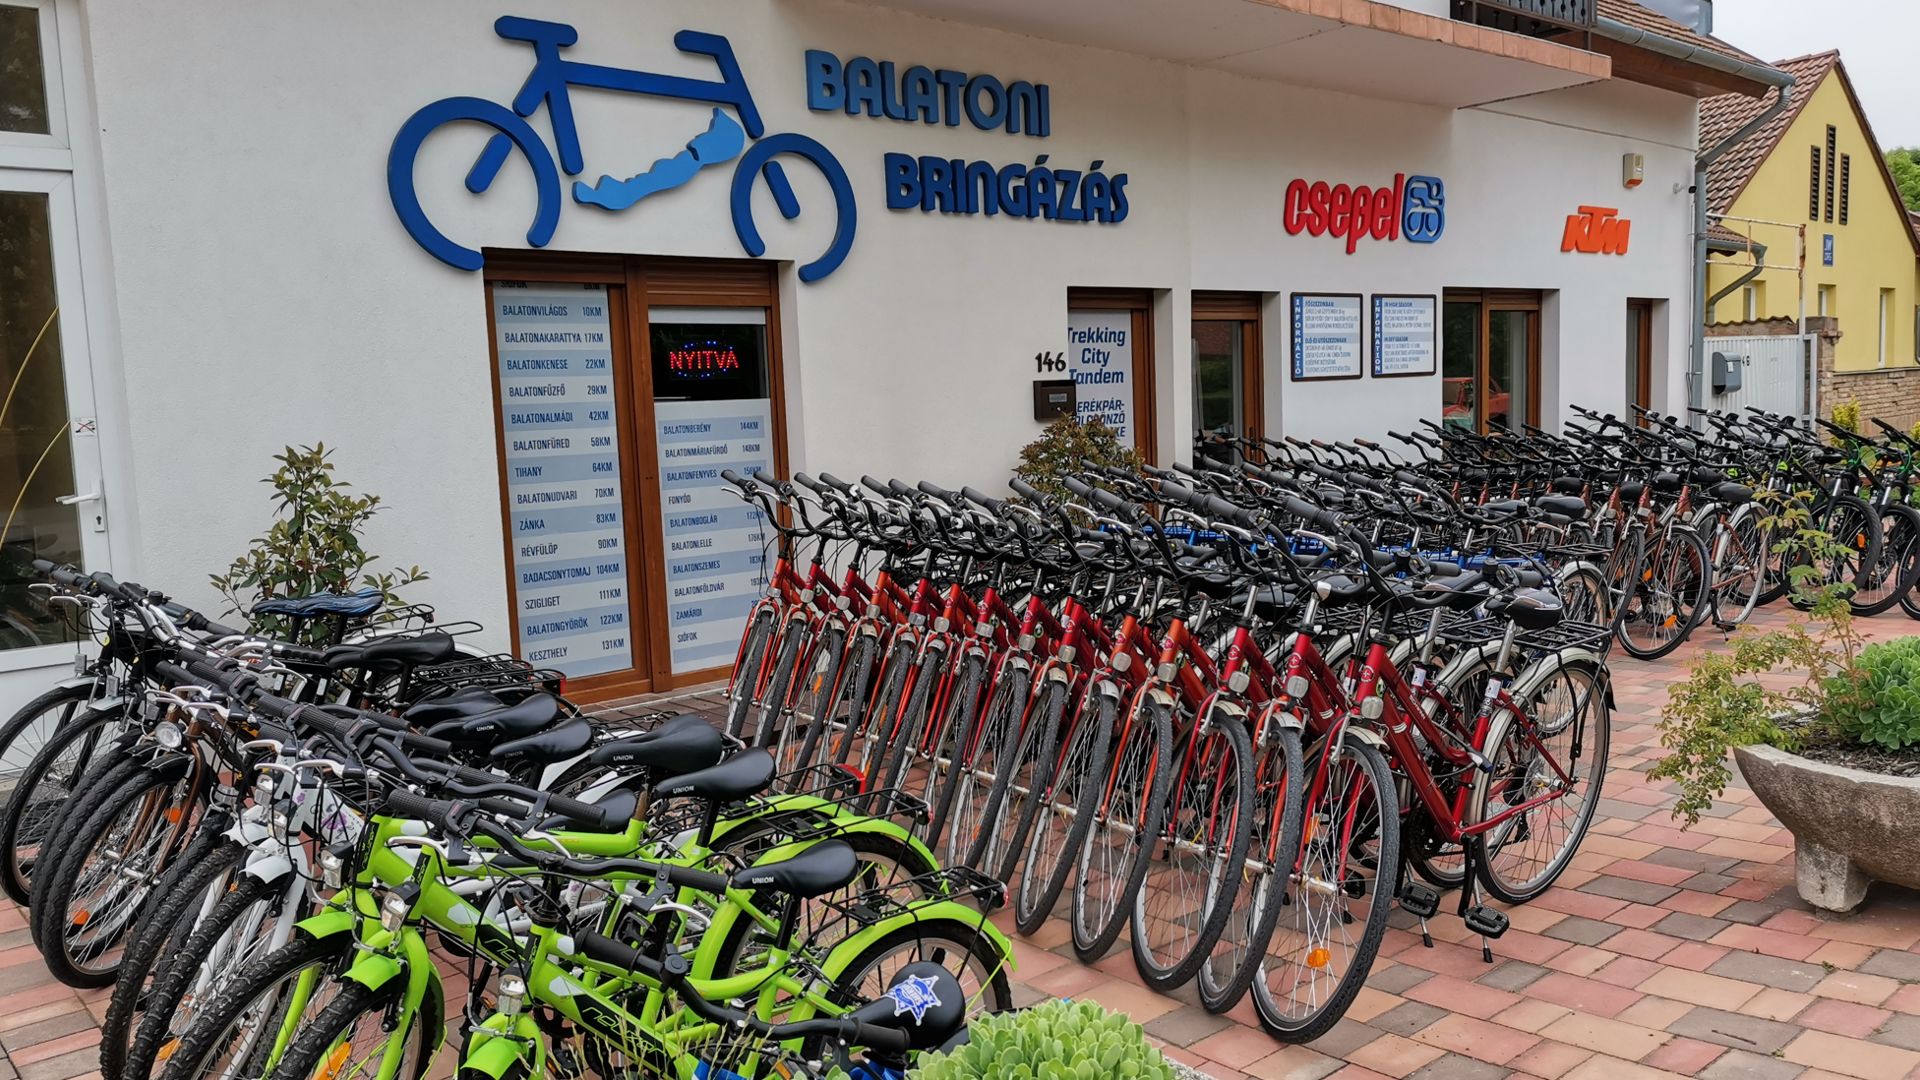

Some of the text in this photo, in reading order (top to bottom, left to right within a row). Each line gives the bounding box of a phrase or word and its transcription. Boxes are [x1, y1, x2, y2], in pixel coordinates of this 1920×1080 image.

[805, 49, 1050, 137] BALATONI
[884, 152, 1128, 223] BRINGÁZÁS
[1561, 205, 1631, 255] KTM
[502, 304, 602, 316] BALATONVILÁGOS 10KM
[504, 332, 604, 343] BALATONAKARATTYA 17KM
[506, 358, 606, 370] BALATONKENESE 22KM
[669, 350, 740, 369] NYITVA
[1035, 351, 1067, 373] 146
[1081, 347, 1111, 367] City
[1069, 368, 1124, 385] Tandem
[587, 385, 607, 395] 29KM
[511, 410, 609, 424] BALATONALMÁDI 42KM
[513, 436, 610, 451] BALATONFÜRED 58KM
[515, 462, 612, 478] TIHANY 64KM
[667, 469, 718, 482] BALATONFENYVES
[517, 488, 614, 504] BALATONUDVARI 70KM
[520, 513, 616, 531] ZÁNKA 83KM
[521, 538, 618, 558] RÉVFÜLÖP 90KM
[672, 538, 712, 551] BALATONLELLE
[523, 563, 620, 584] BADACSONYTOMAJ 104KM
[673, 560, 720, 574] BALATONSZEMES
[525, 588, 621, 610] SZIGLIGET 111KM
[527, 613, 622, 636] BALATONGYÖRÖK 122KM
[677, 632, 698, 643] SIÓFOK
[528, 638, 624, 662] KESZTHELY 131KM
[613, 754, 634, 762] UNION
[672, 786, 694, 794] UNION
[752, 876, 774, 884] UNION
